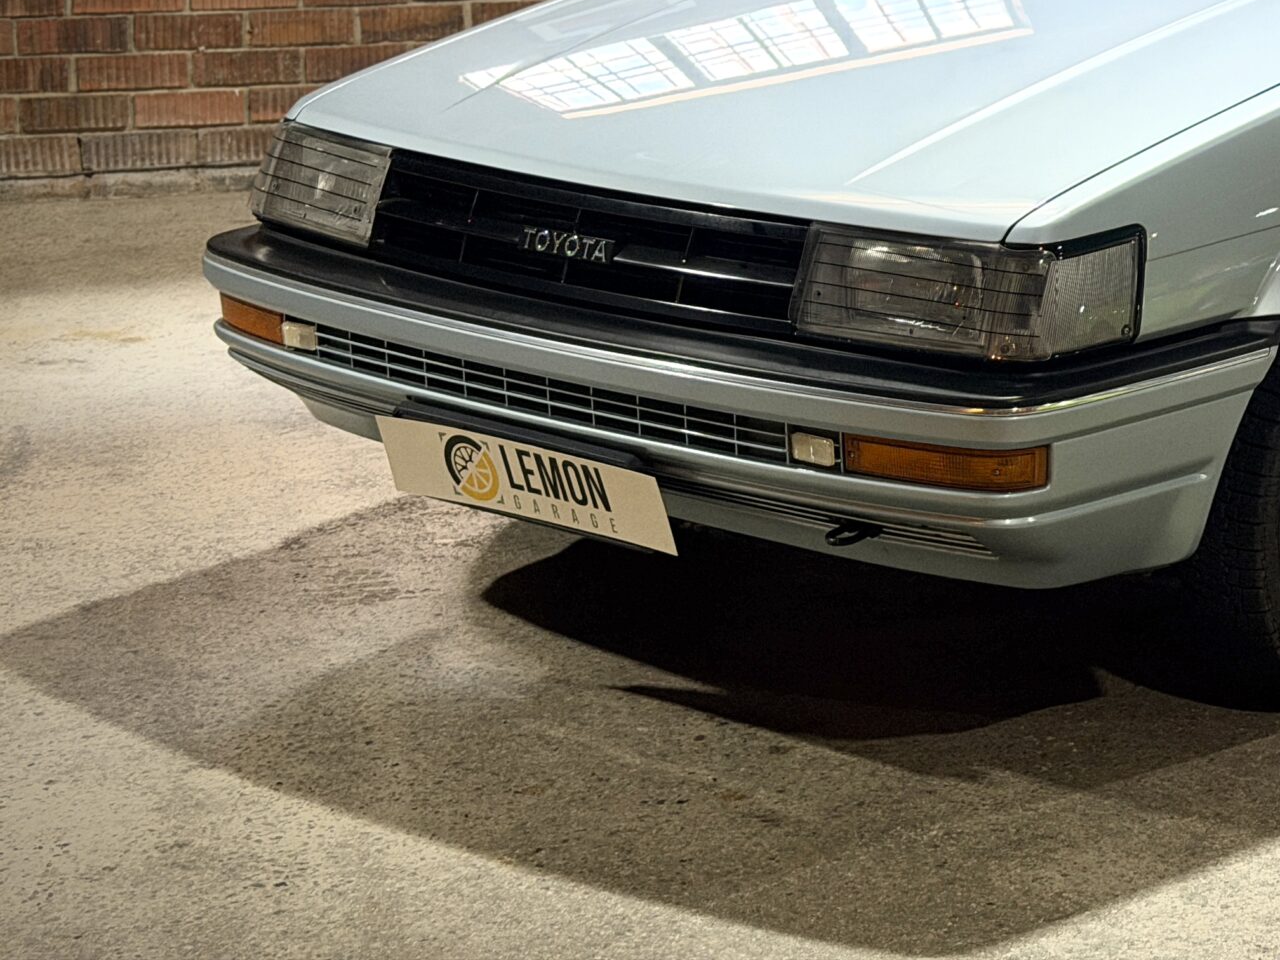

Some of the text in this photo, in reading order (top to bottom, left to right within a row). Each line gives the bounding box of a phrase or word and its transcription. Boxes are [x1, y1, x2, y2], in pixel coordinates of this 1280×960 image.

[523, 228, 606, 262] TOYOTA
[498, 444, 612, 512] LEMON
[513, 495, 619, 533] GARAGE
